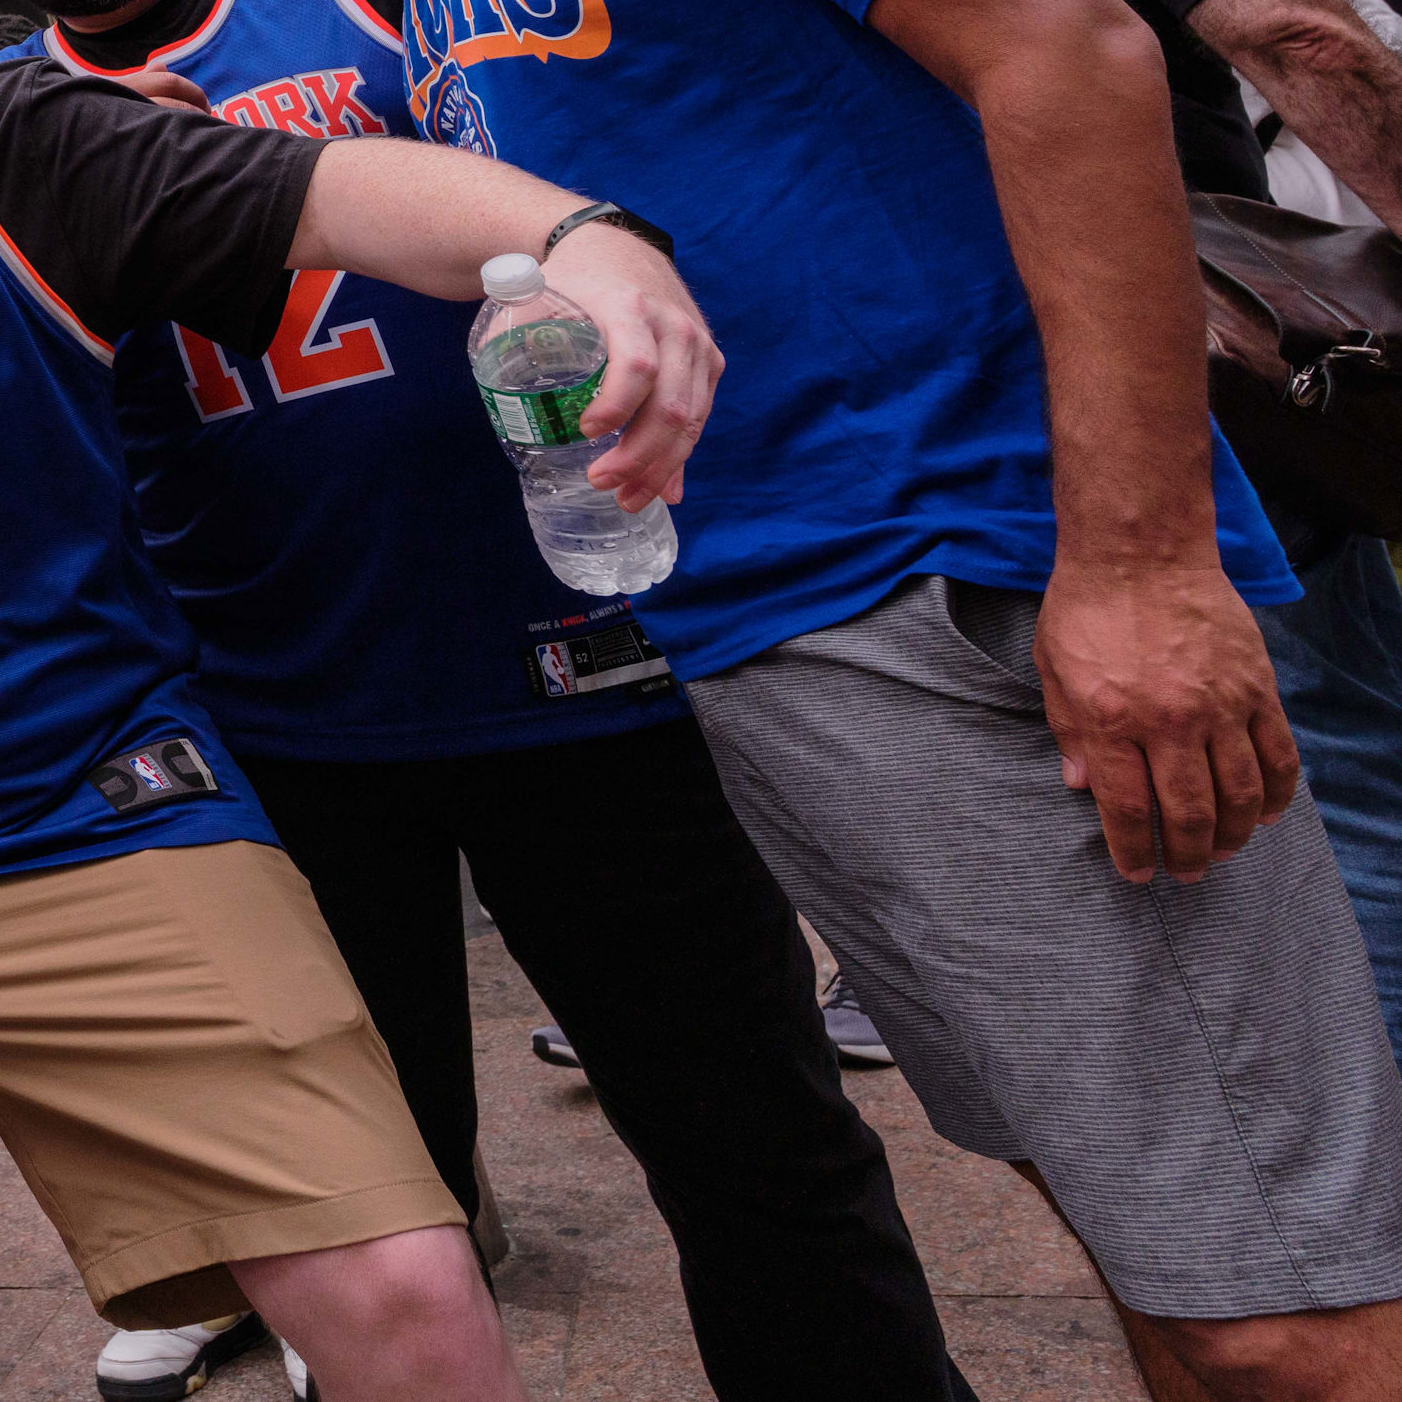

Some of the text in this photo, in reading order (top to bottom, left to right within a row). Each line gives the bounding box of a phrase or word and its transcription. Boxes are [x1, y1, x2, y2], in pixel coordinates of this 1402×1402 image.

[210, 66, 390, 139] ORK
[528, 621, 552, 632] ONCE
[554, 620, 561, 629] A
[589, 606, 618, 620] ALWAYS
[576, 653, 589, 664] 52
